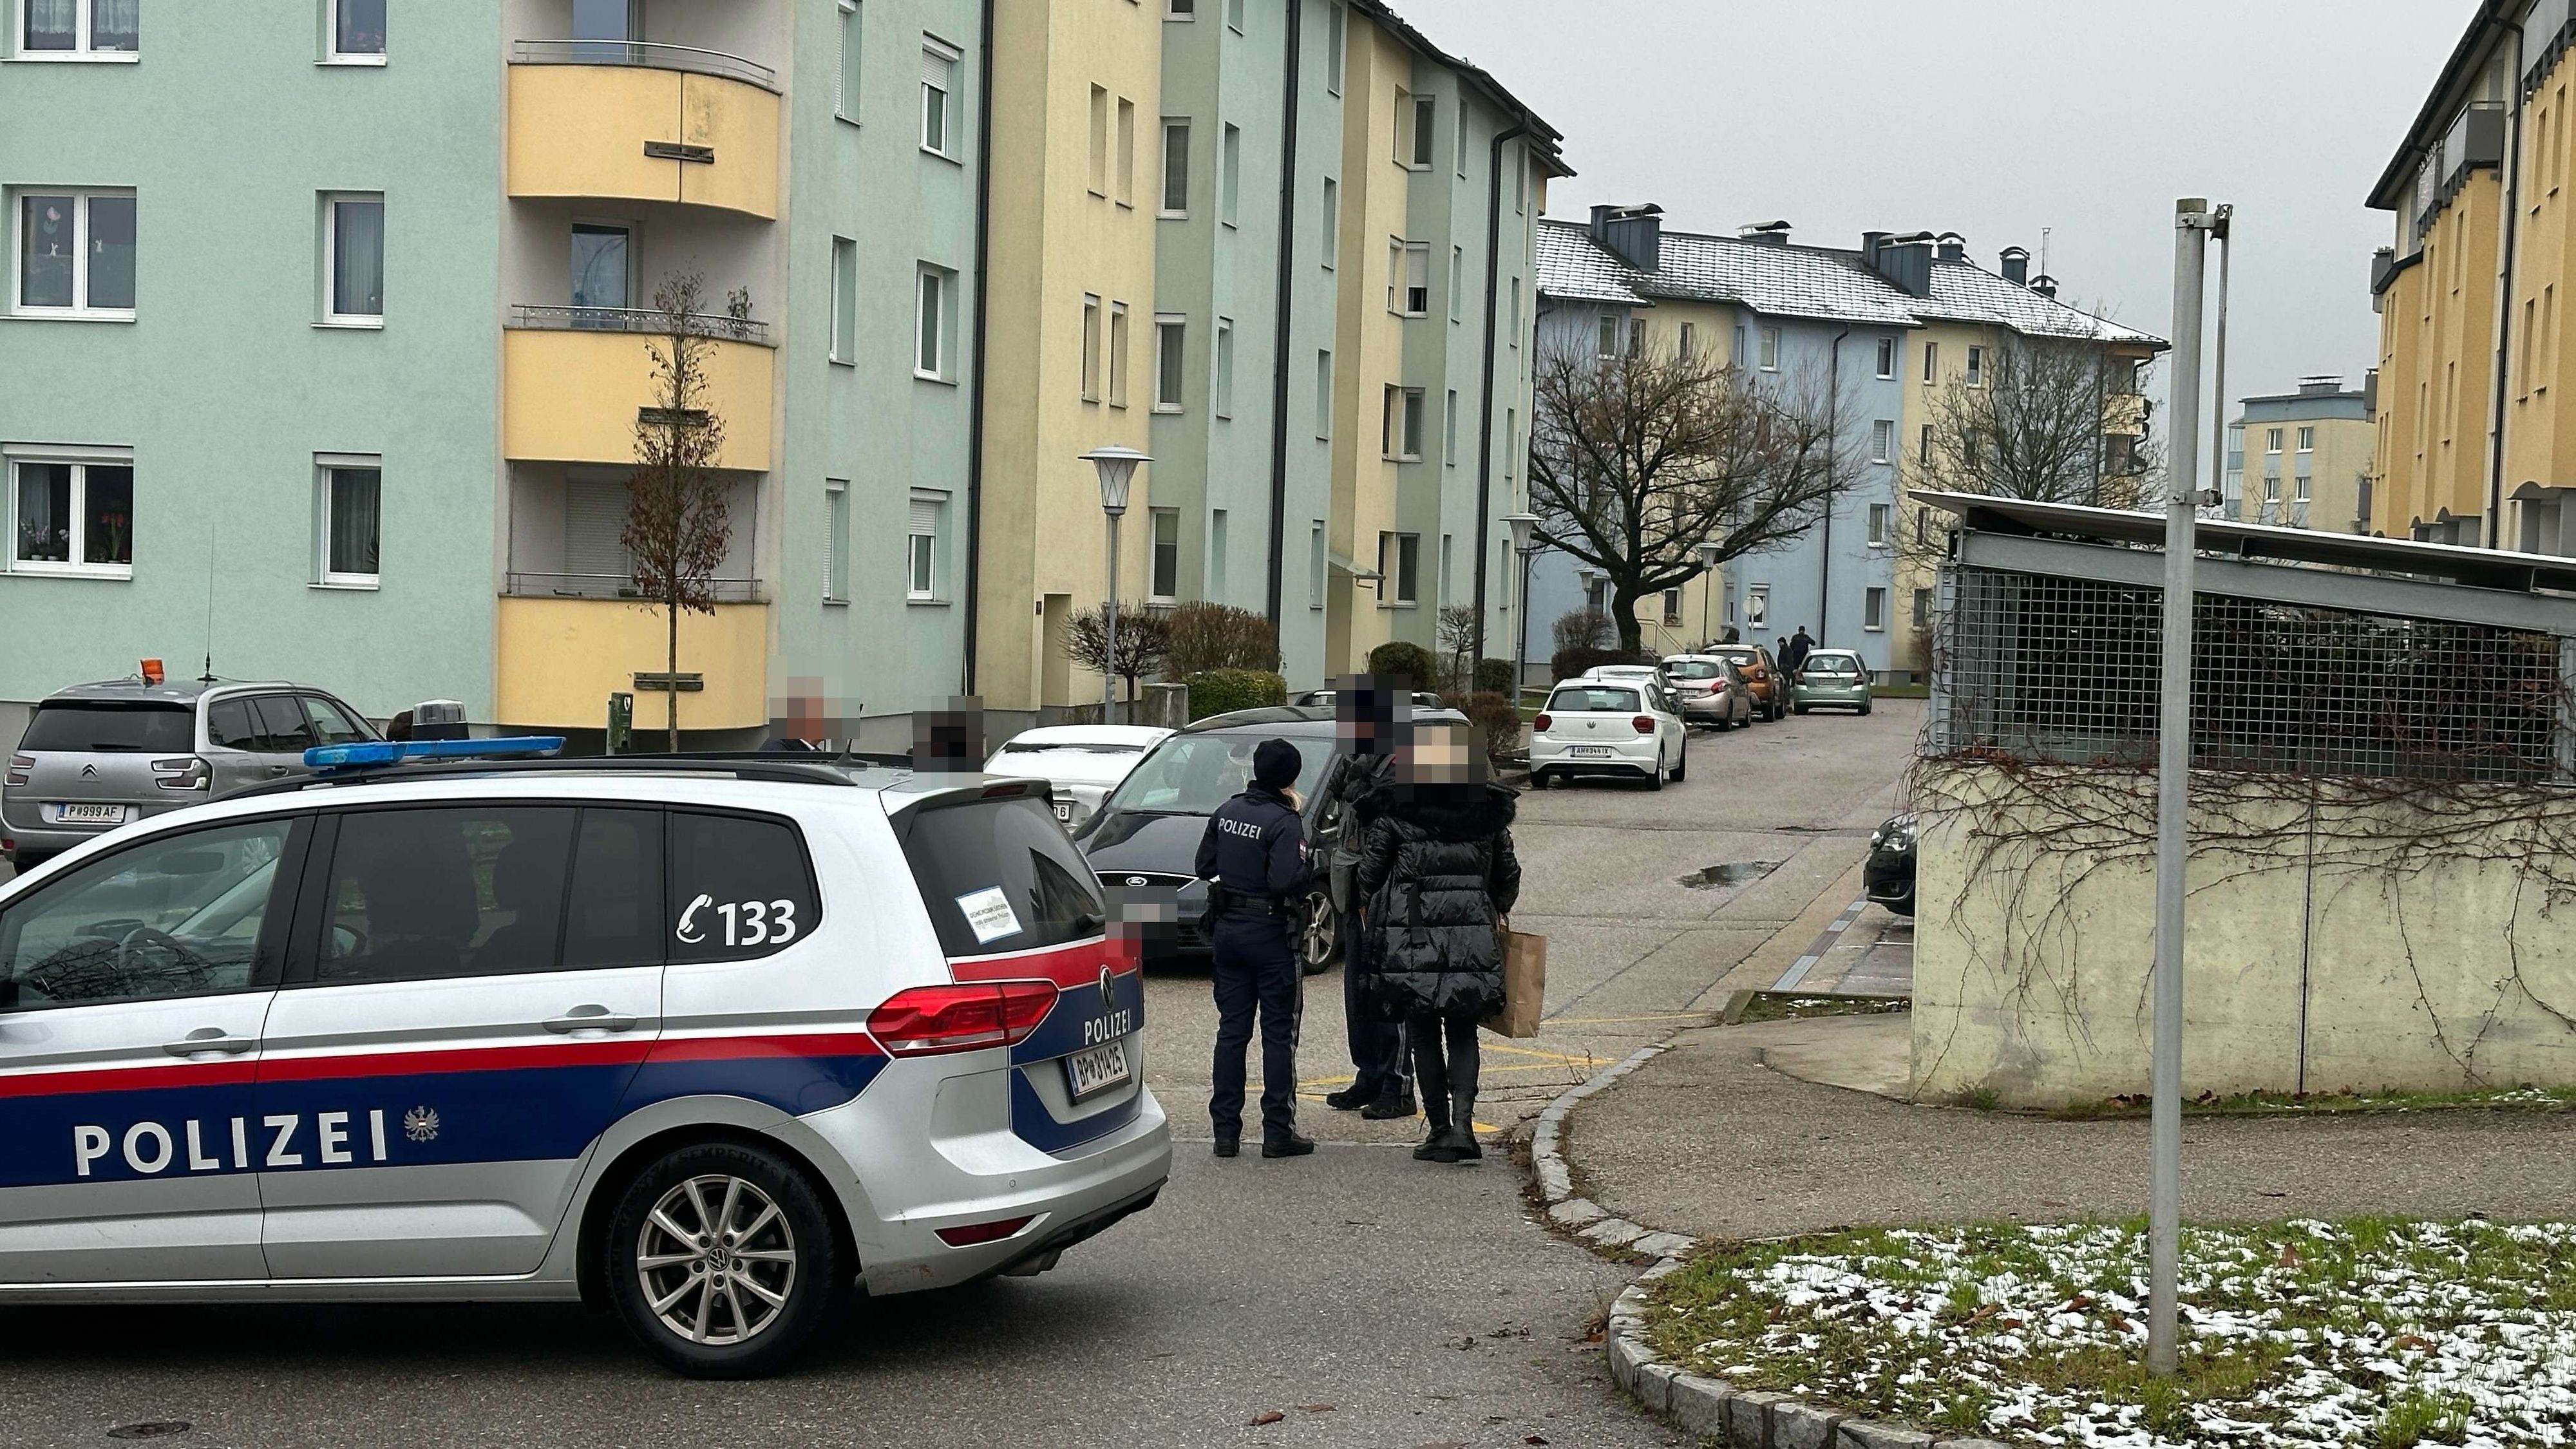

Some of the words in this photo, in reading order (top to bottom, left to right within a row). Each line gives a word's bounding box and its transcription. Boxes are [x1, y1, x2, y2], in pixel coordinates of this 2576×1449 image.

[69, 806, 76, 817] P
[82, 806, 102, 817] 999
[103, 806, 117, 817] AF
[1218, 817, 1262, 840] POLIZEI
[717, 899, 796, 946] 133
[1084, 1008, 1130, 1045] POLIZEI
[1076, 1057, 1090, 1087] BP
[1094, 1046, 1123, 1081] 31425
[74, 1110, 386, 1176] POLIZEI
